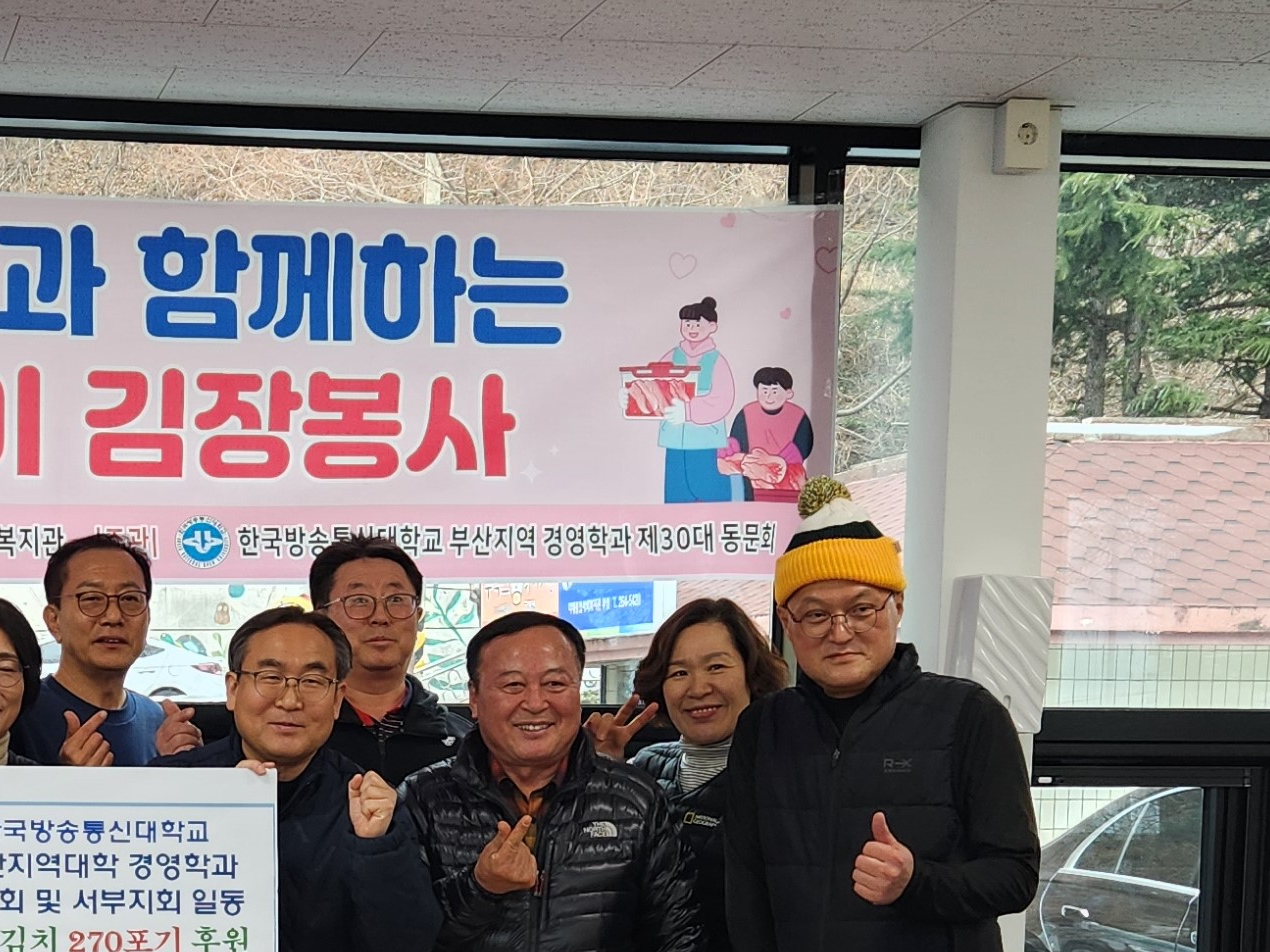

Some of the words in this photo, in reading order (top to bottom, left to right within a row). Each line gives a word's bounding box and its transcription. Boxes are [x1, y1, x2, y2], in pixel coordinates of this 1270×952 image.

[137, 226, 569, 344] 함께하는
[84, 368, 516, 479] 김장봉사
[450, 523, 534, 557] 부산지역
[543, 523, 632, 557] 경영학과
[637, 523, 714, 554] 제30대
[721, 521, 776, 555] 동문회
[129, 853, 239, 880] 경영학과
[36, 889, 61, 915] 및
[73, 888, 181, 915] 서부지회
[192, 888, 245, 916] 일동
